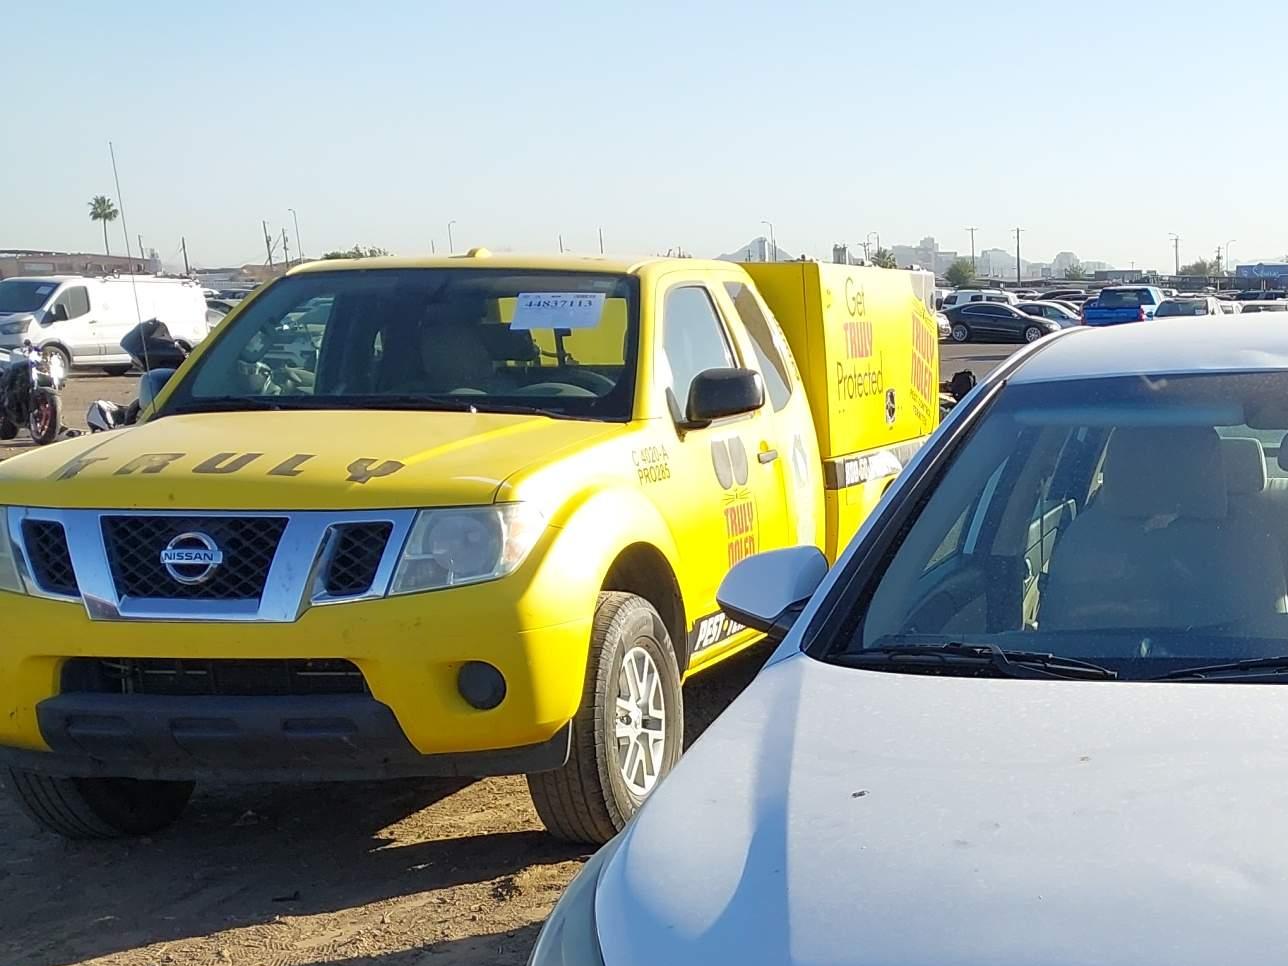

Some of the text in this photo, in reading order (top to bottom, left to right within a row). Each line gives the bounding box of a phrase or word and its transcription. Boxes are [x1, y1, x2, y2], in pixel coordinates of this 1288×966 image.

[526, 299, 593, 308] 44837113
[845, 276, 866, 317] Get
[843, 321, 873, 358] TRULY
[911, 311, 934, 365] TRULY
[836, 351, 883, 401] Protected
[54, 451, 405, 485] TRULY
[637, 462, 671, 486] PRO285
[724, 501, 754, 540] TRULY
[164, 552, 214, 561] NISSAN
[694, 612, 726, 651] PEST
